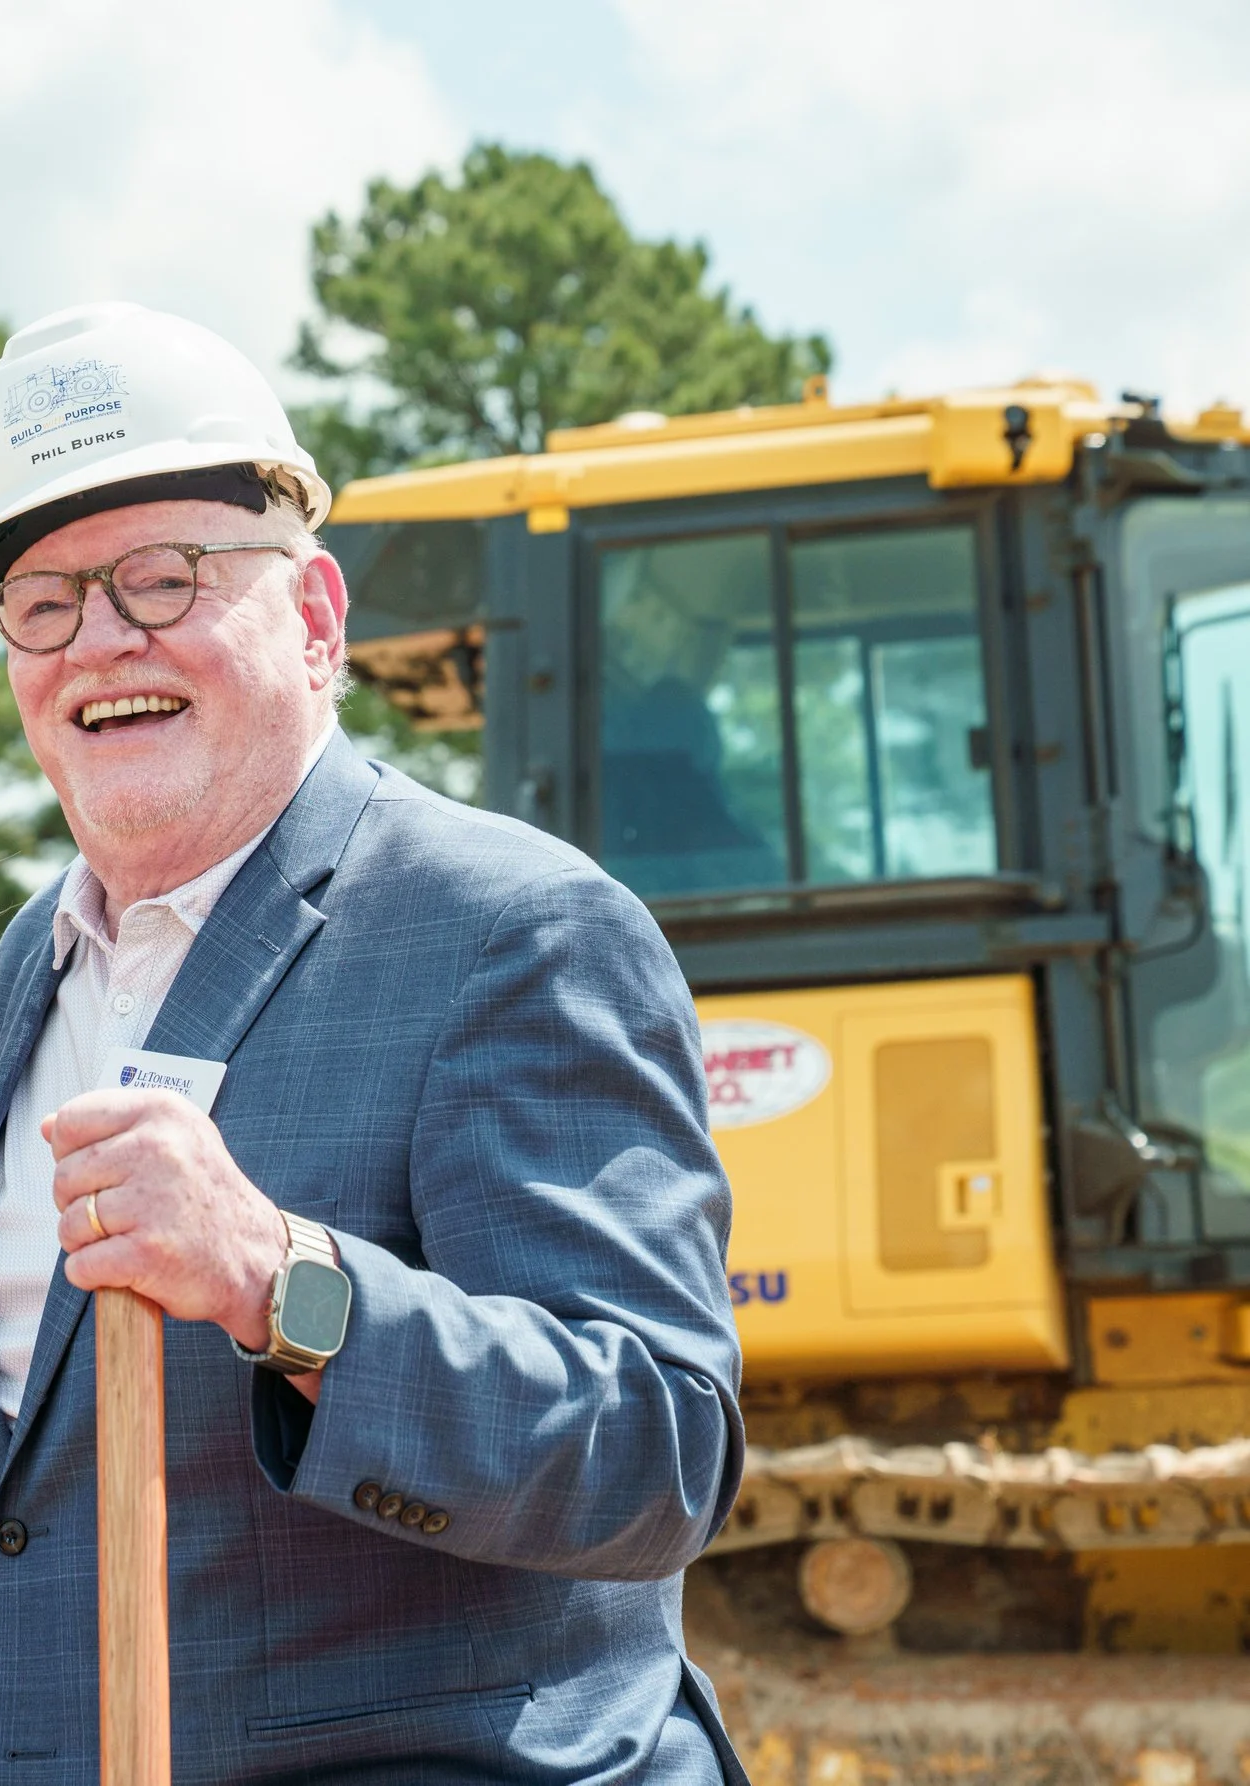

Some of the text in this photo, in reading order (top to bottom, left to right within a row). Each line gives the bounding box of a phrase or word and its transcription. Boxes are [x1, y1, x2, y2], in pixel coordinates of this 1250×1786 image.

[10, 424, 42, 445] BUILD
[65, 400, 122, 421] PURPOSE
[31, 446, 67, 464] PHIL
